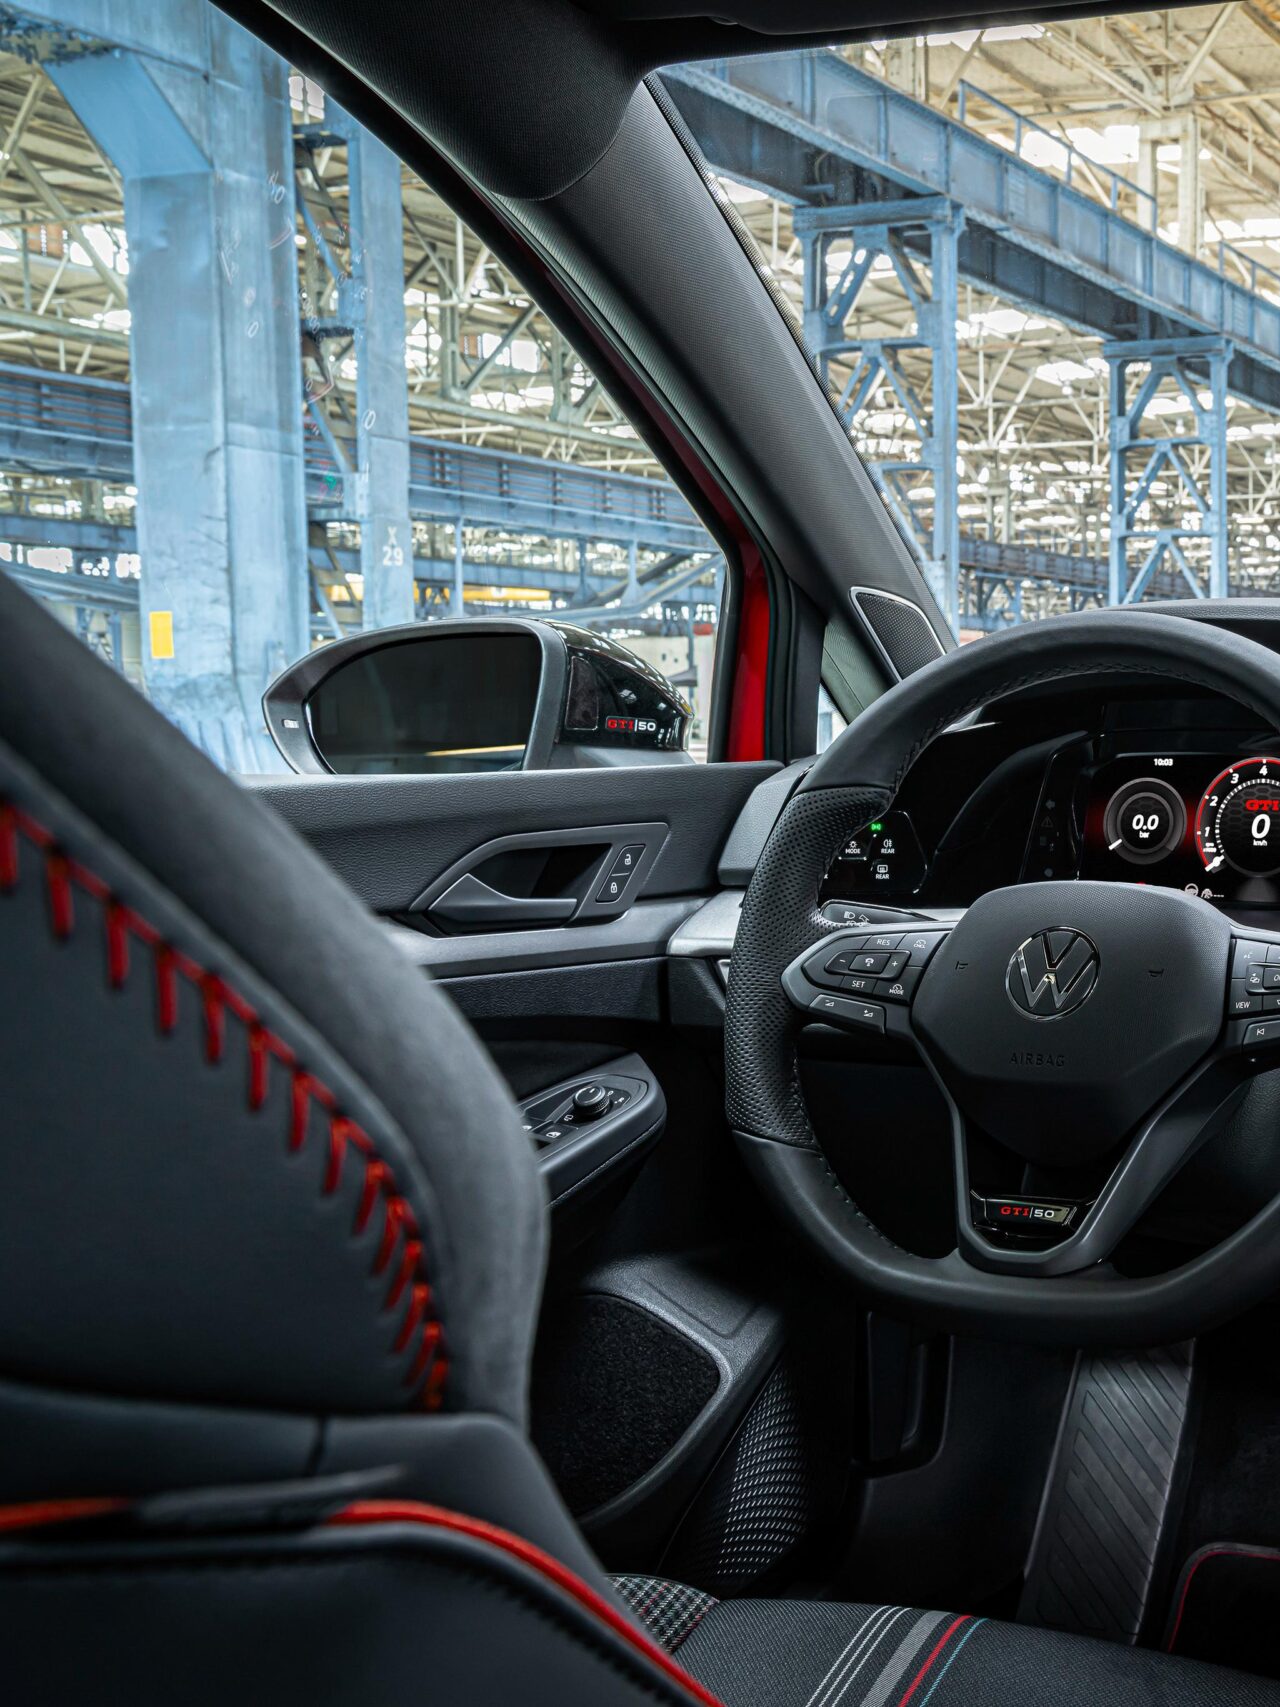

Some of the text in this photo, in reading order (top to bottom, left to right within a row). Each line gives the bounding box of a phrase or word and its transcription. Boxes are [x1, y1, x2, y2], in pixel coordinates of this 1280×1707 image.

[382, 547, 404, 566] 29
[1153, 758, 1173, 767] 10:03
[1259, 765, 1268, 776] 4
[1230, 773, 1239, 784] 3
[1209, 795, 1219, 807] 2
[1245, 799, 1280, 811] GTI
[1132, 814, 1159, 830] 0.0
[1251, 813, 1271, 839] 0
[1204, 826, 1211, 838] 1
[1253, 839, 1268, 847] km/h
[877, 938, 890, 946] RES
[852, 980, 866, 988] SET
[1010, 1053, 1065, 1066] AIRBAG
